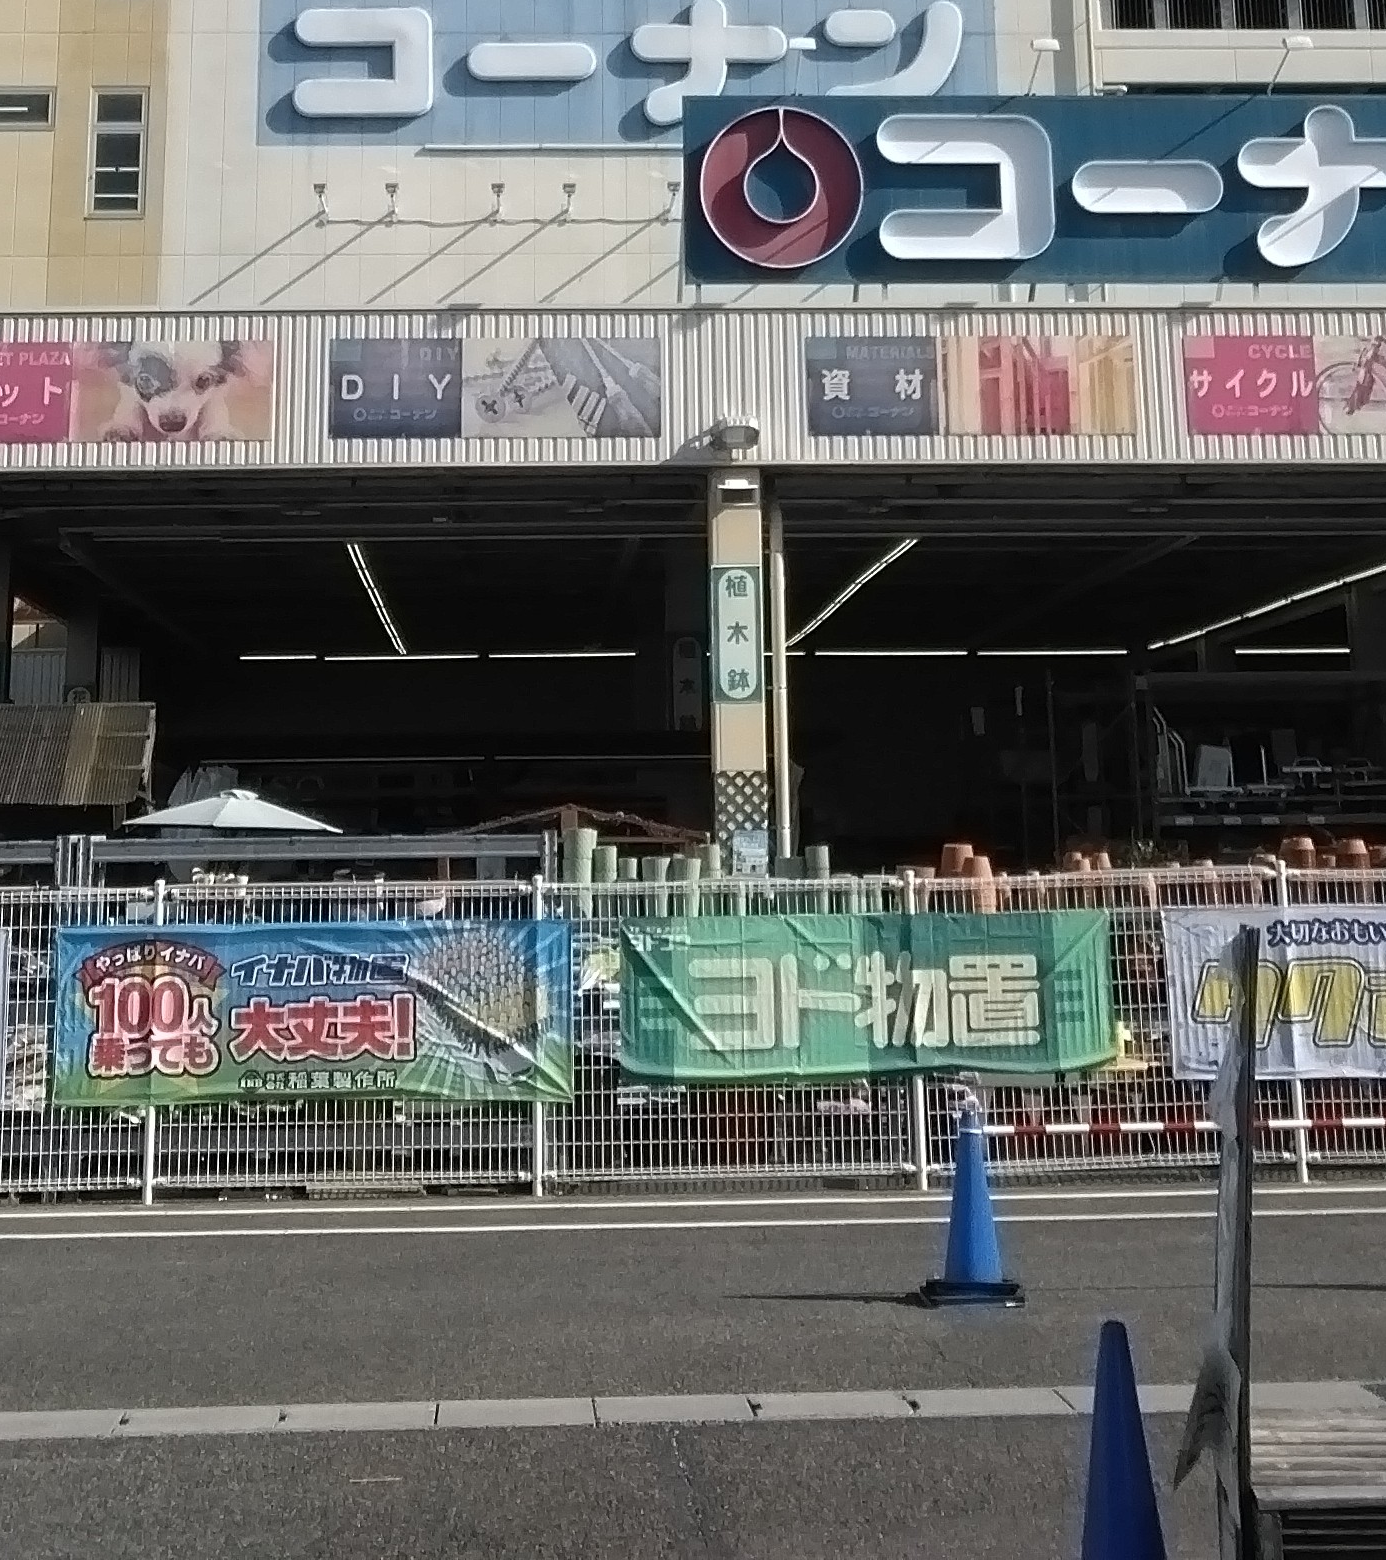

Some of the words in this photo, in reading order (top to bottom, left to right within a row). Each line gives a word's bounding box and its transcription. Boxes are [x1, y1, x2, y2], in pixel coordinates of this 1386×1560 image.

[19, 351, 71, 366] PLAZA
[420, 347, 459, 361] DIY
[1248, 344, 1312, 359] CYCLE
[341, 374, 451, 400] DIY
[821, 368, 923, 400] 資材
[1190, 369, 1313, 398] サイクル
[725, 574, 751, 692] 植木鉢
[89, 976, 220, 1037] 100人
[688, 950, 1042, 1051] ヨド物置
[230, 994, 416, 1062] 大丈夫!
[88, 1035, 221, 1077] 乗っても
